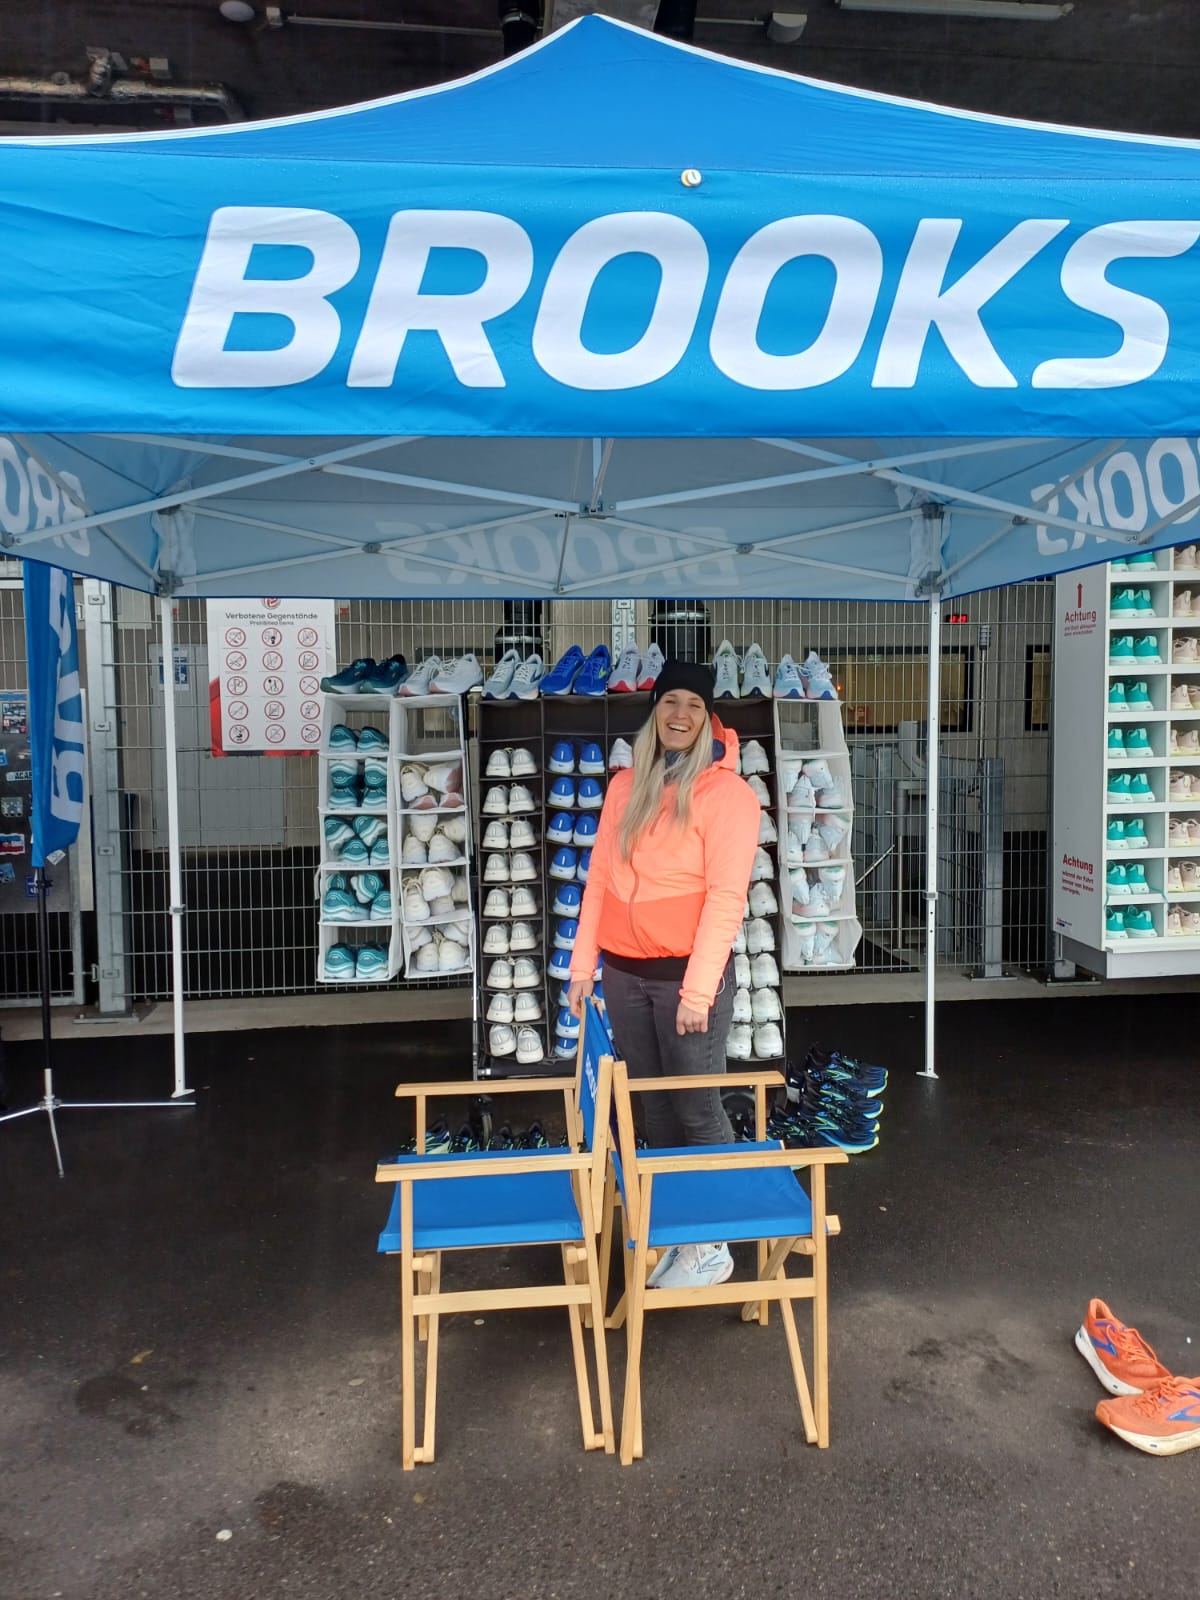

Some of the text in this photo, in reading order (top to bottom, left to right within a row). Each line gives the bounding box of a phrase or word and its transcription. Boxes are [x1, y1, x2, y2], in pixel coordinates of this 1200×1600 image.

[172, 206, 1200, 390] BROOKS
[1064, 610, 1096, 623] Achtung
[1062, 854, 1093, 874] Achtung
